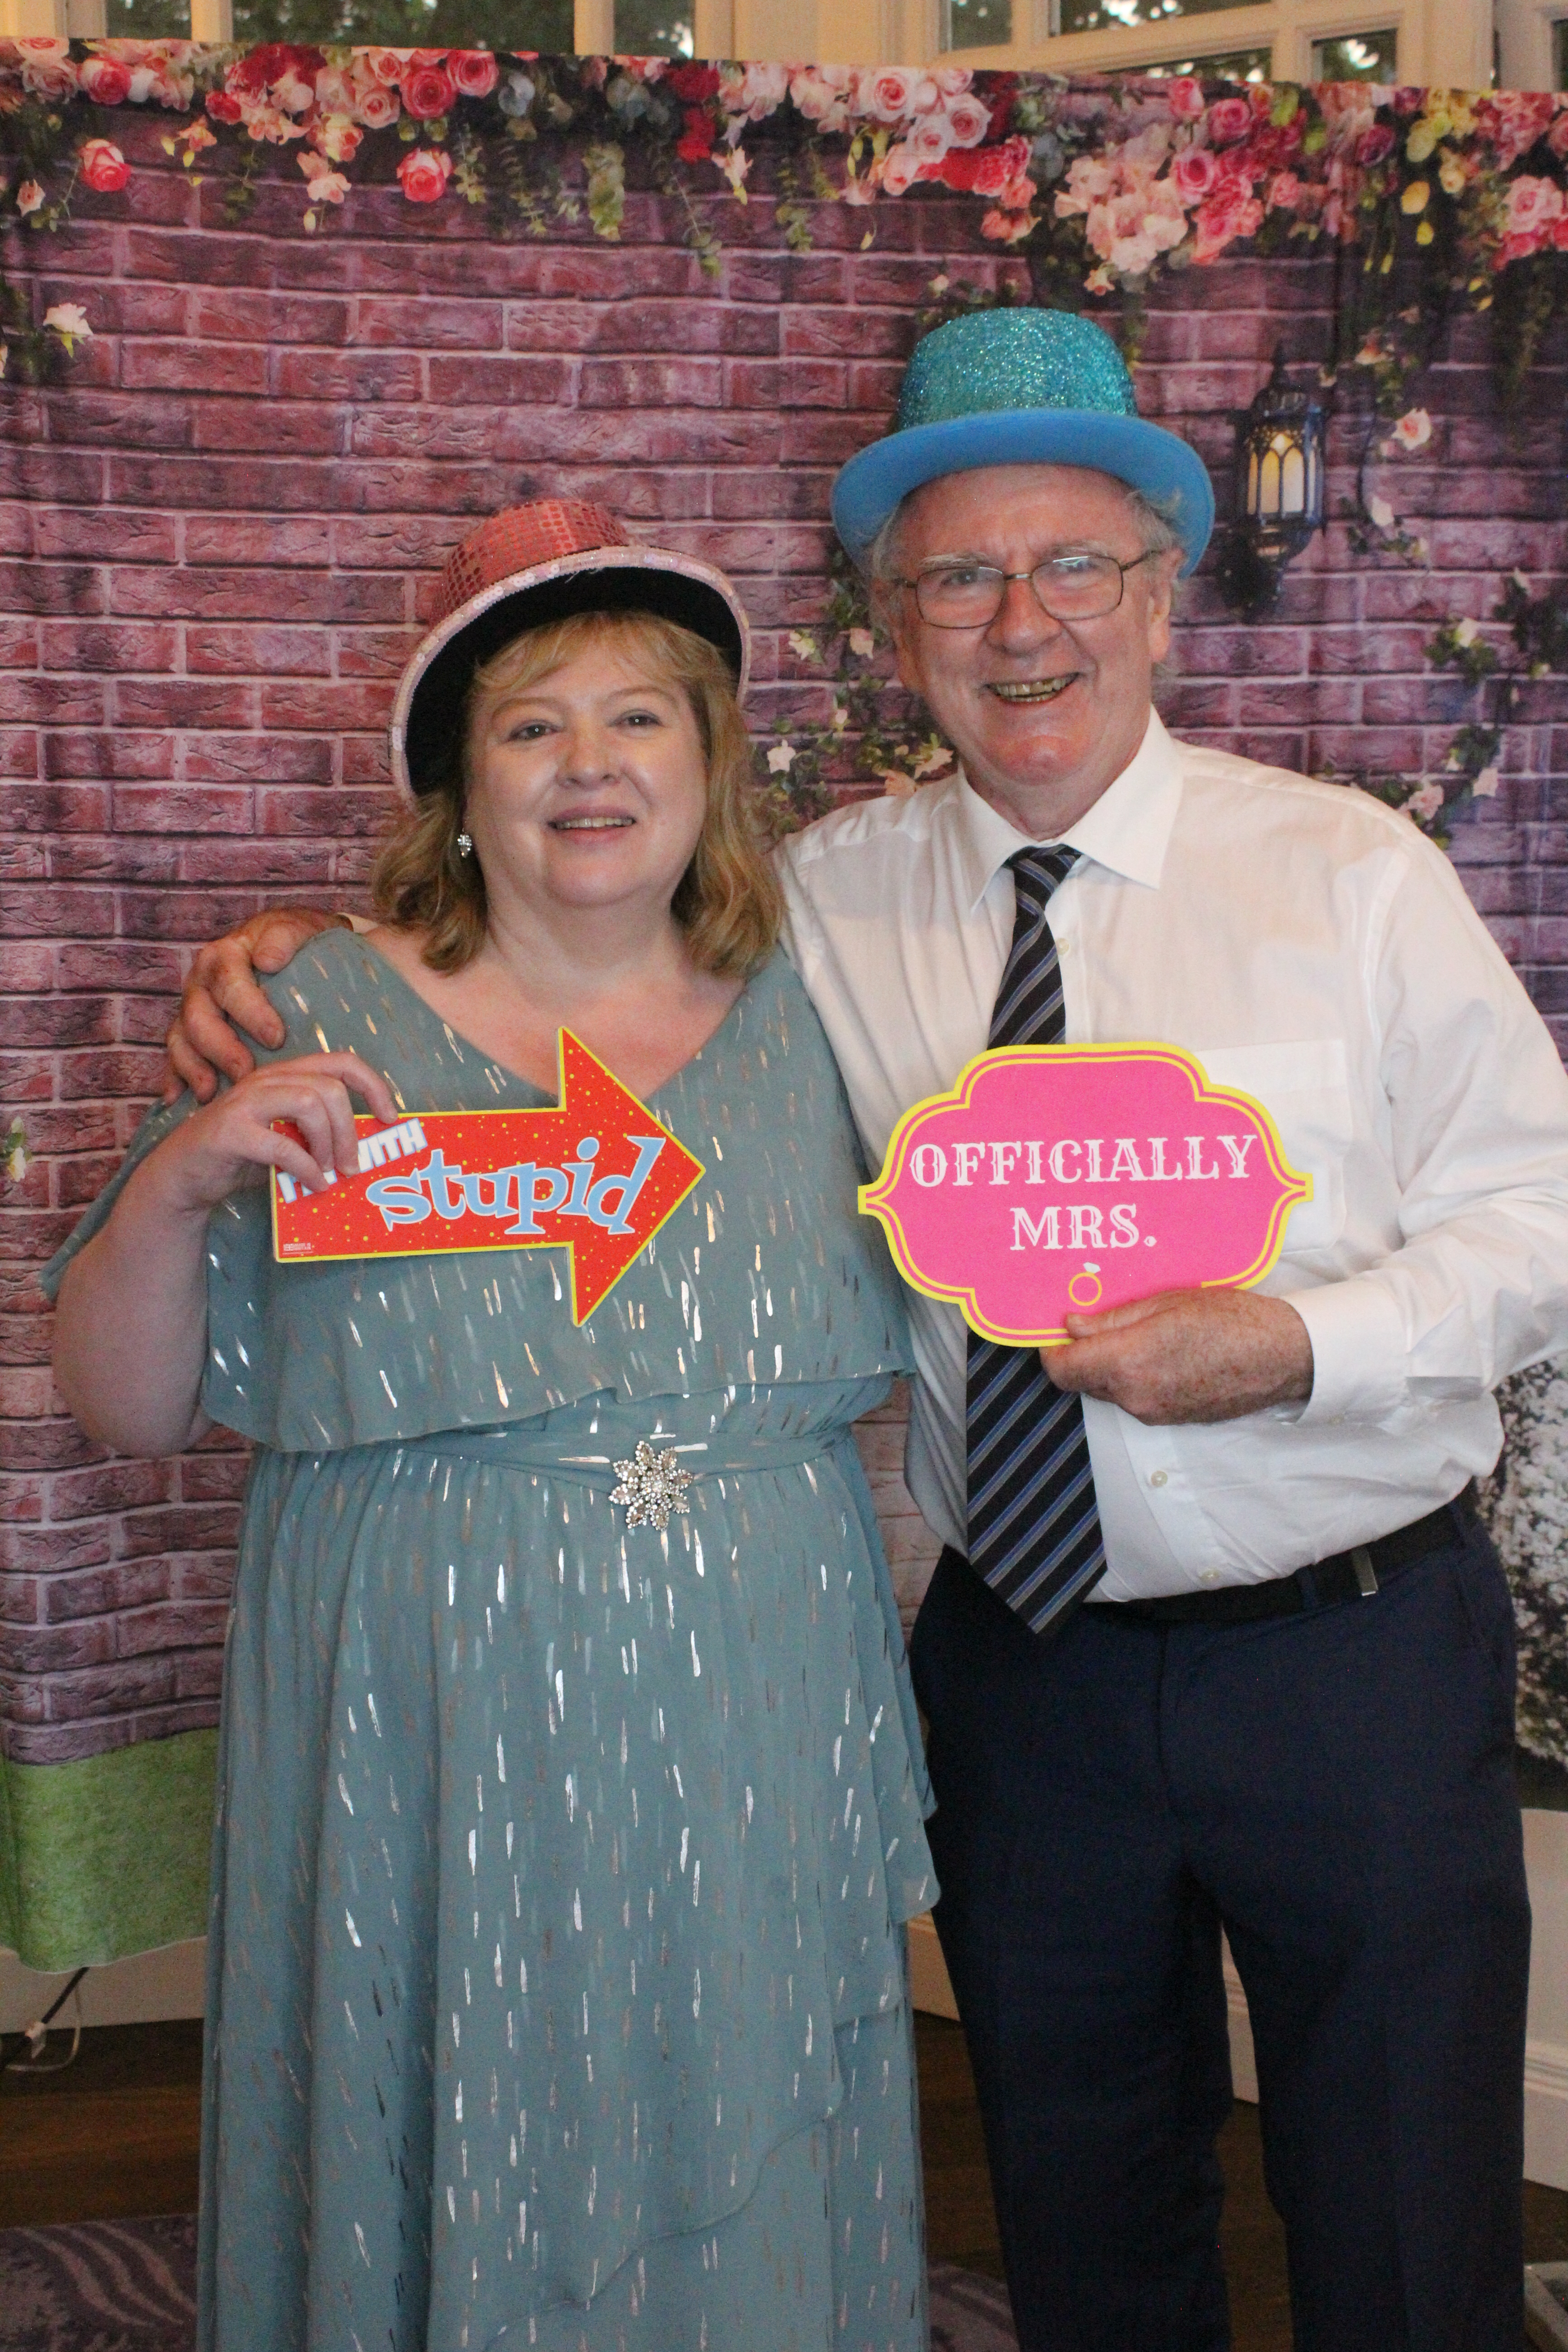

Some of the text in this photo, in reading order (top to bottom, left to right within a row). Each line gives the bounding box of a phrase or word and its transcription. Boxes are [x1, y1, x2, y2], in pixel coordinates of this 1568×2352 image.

[365, 1136, 666, 1235] stupid
[909, 1135, 1258, 1187] OFFICIALLY
[1009, 1203, 1157, 1251] MRS.
